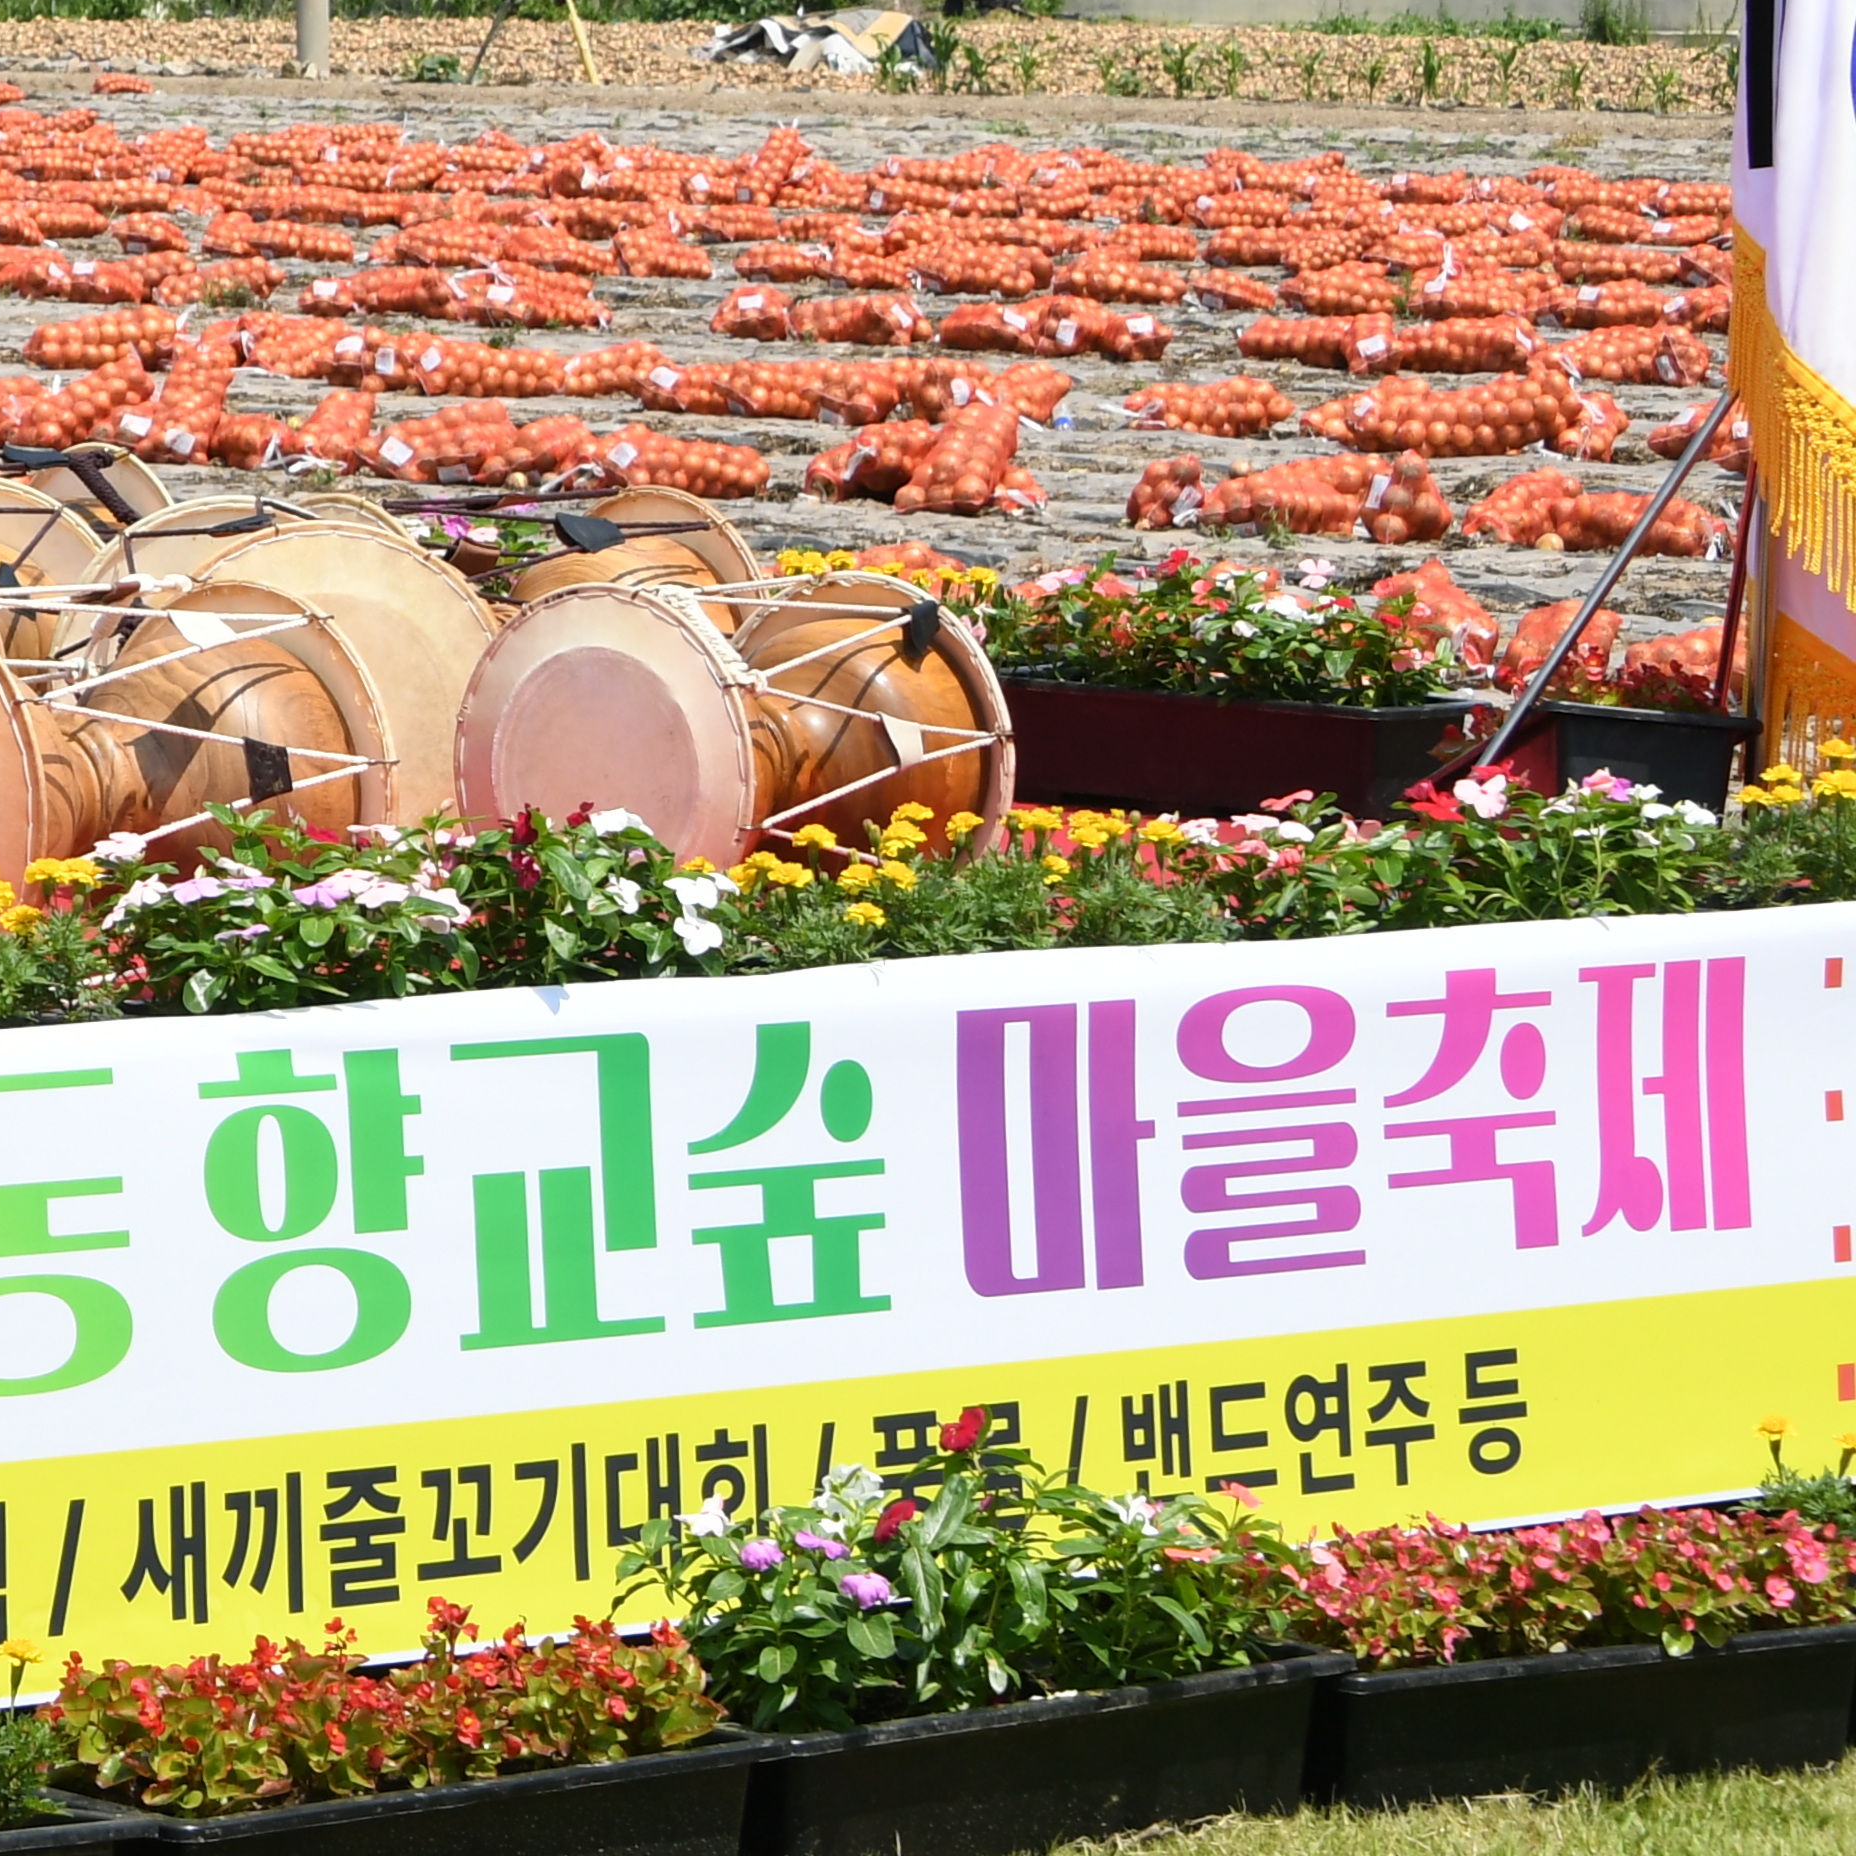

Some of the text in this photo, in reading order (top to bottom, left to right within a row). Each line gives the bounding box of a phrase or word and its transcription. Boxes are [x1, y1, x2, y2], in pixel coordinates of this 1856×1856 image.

[196, 1020, 893, 1373] 향교숲
[956, 955, 1752, 1299] 마을축제
[121, 1424, 770, 1624] 새끼줄꼬기대회
[1120, 1362, 1436, 1502] 밴드연주
[1458, 1348, 1528, 1476] 등
